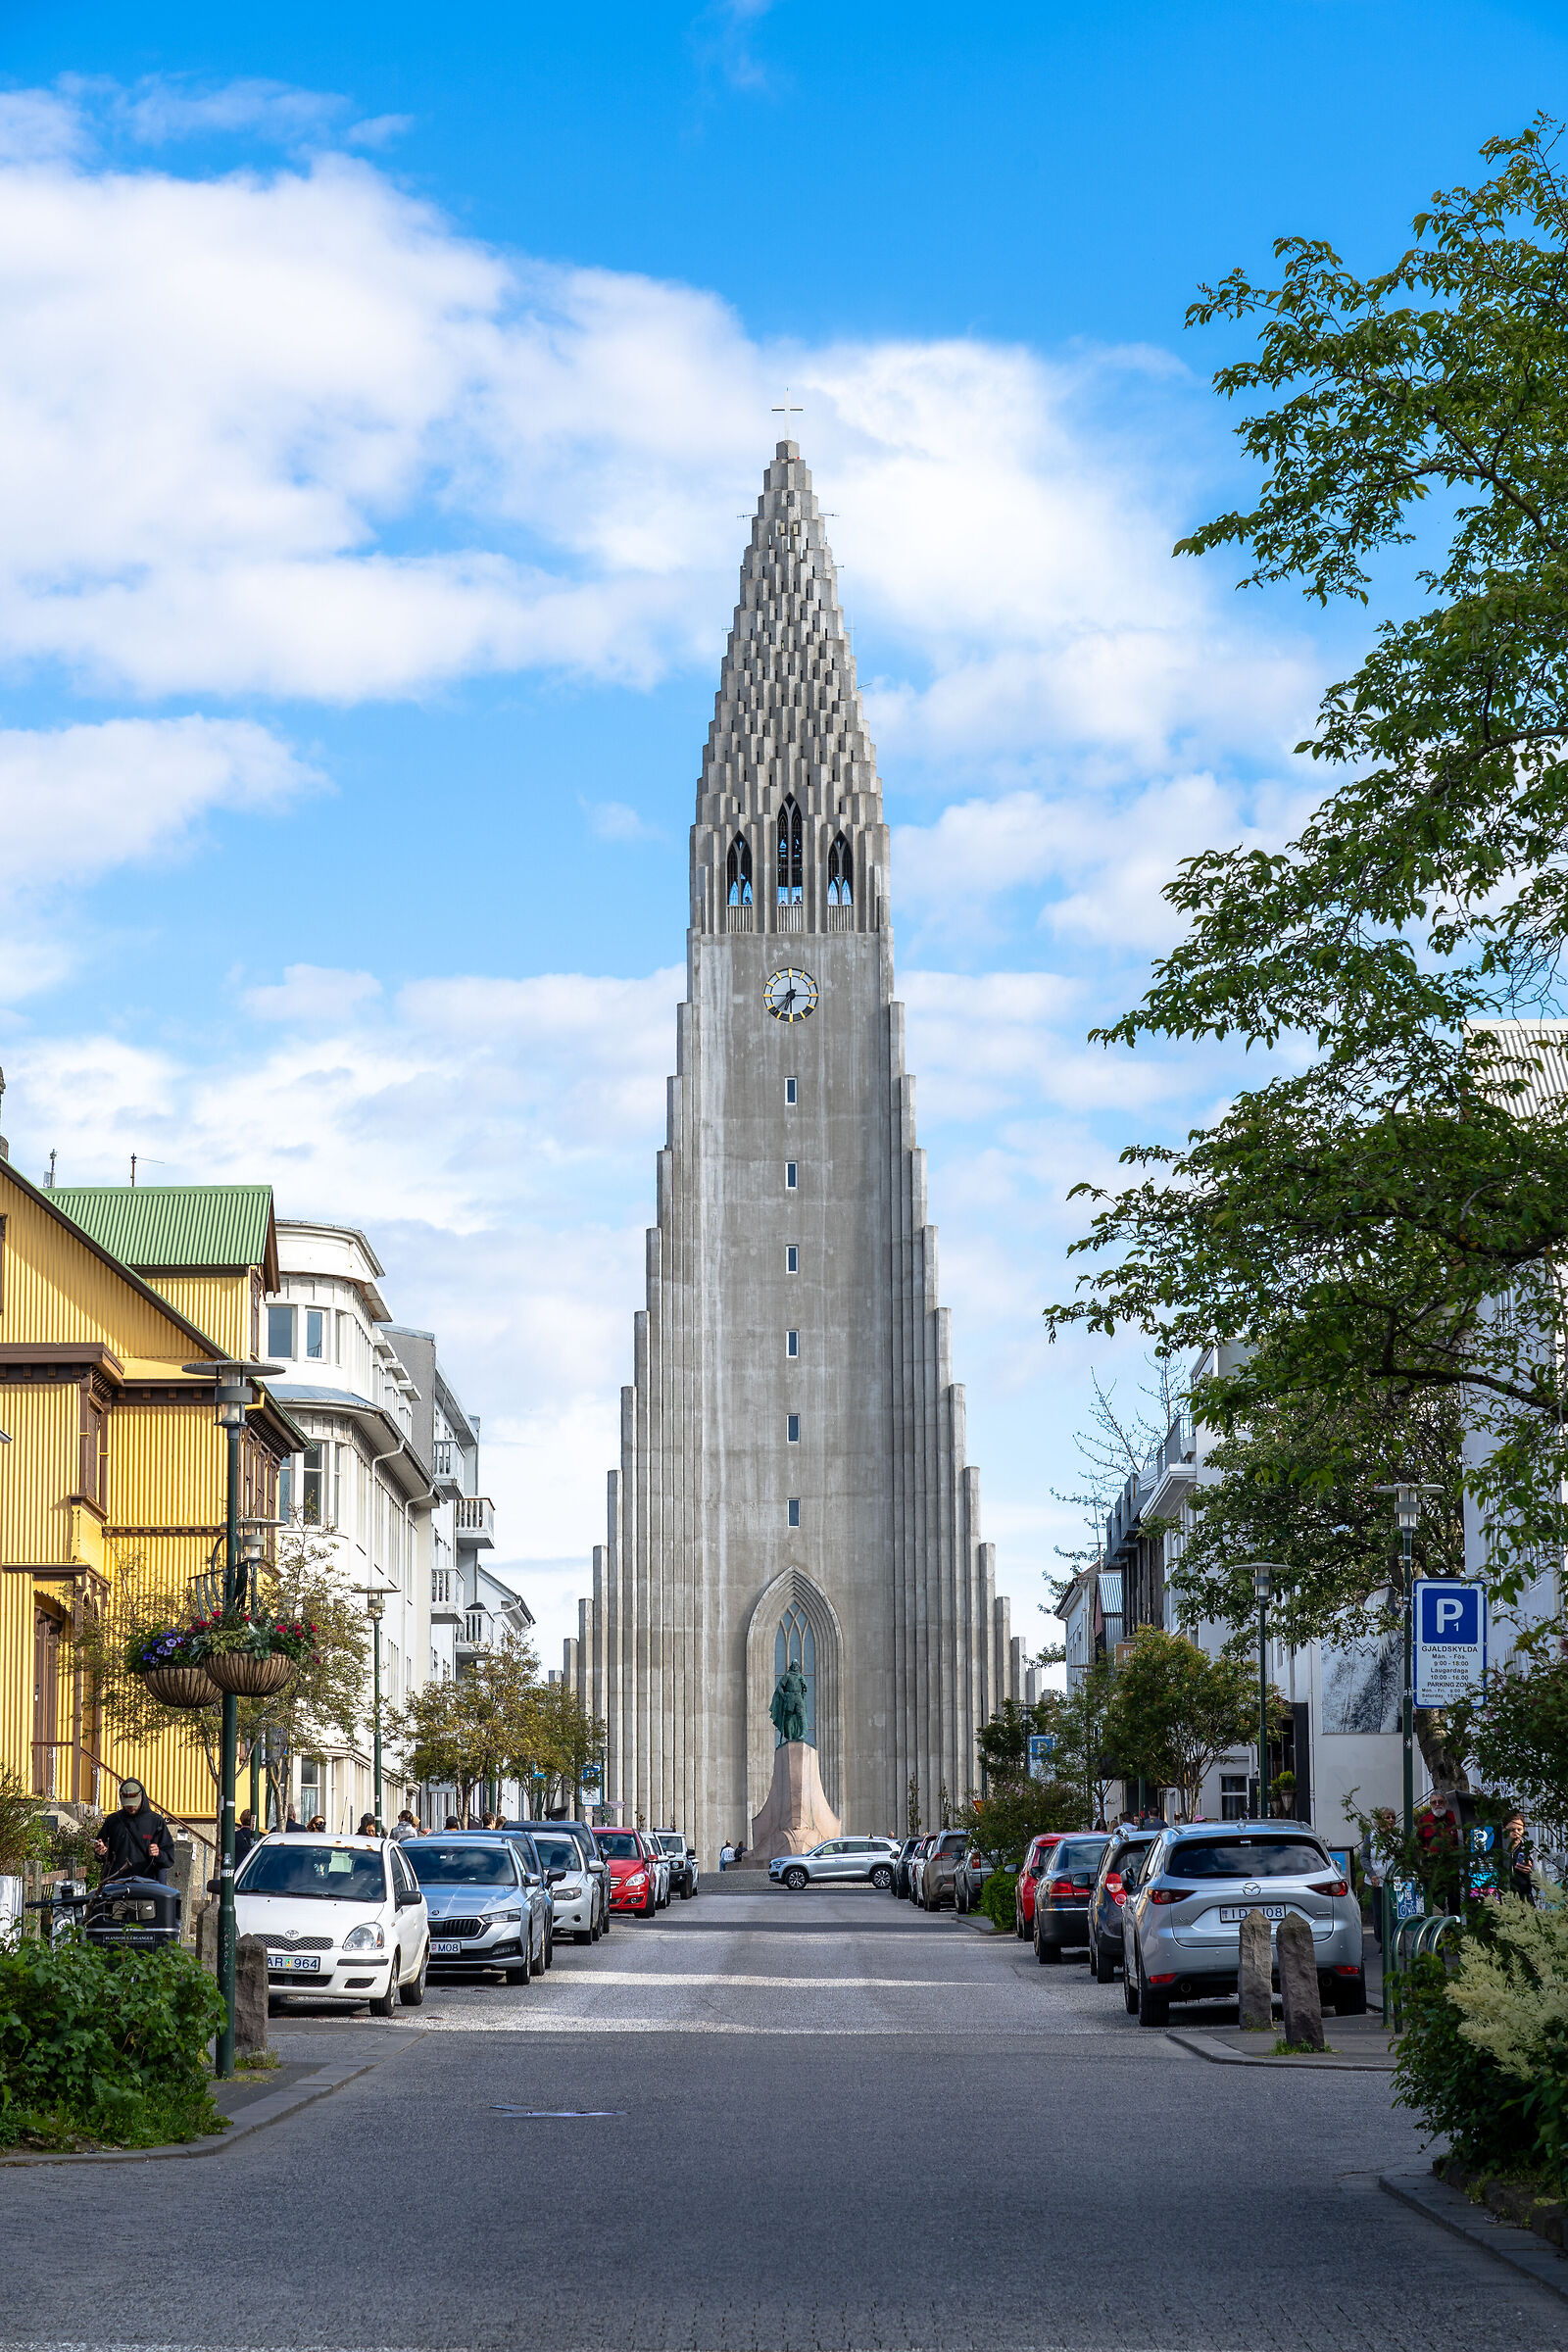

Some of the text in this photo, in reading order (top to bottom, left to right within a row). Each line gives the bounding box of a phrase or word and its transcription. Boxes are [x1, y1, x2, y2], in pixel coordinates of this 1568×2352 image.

[1437, 1598, 1464, 1634] P
[1453, 1622, 1459, 1632] 1
[437, 1943, 459, 1952] M08
[267, 1956, 318, 1969] AR 964
